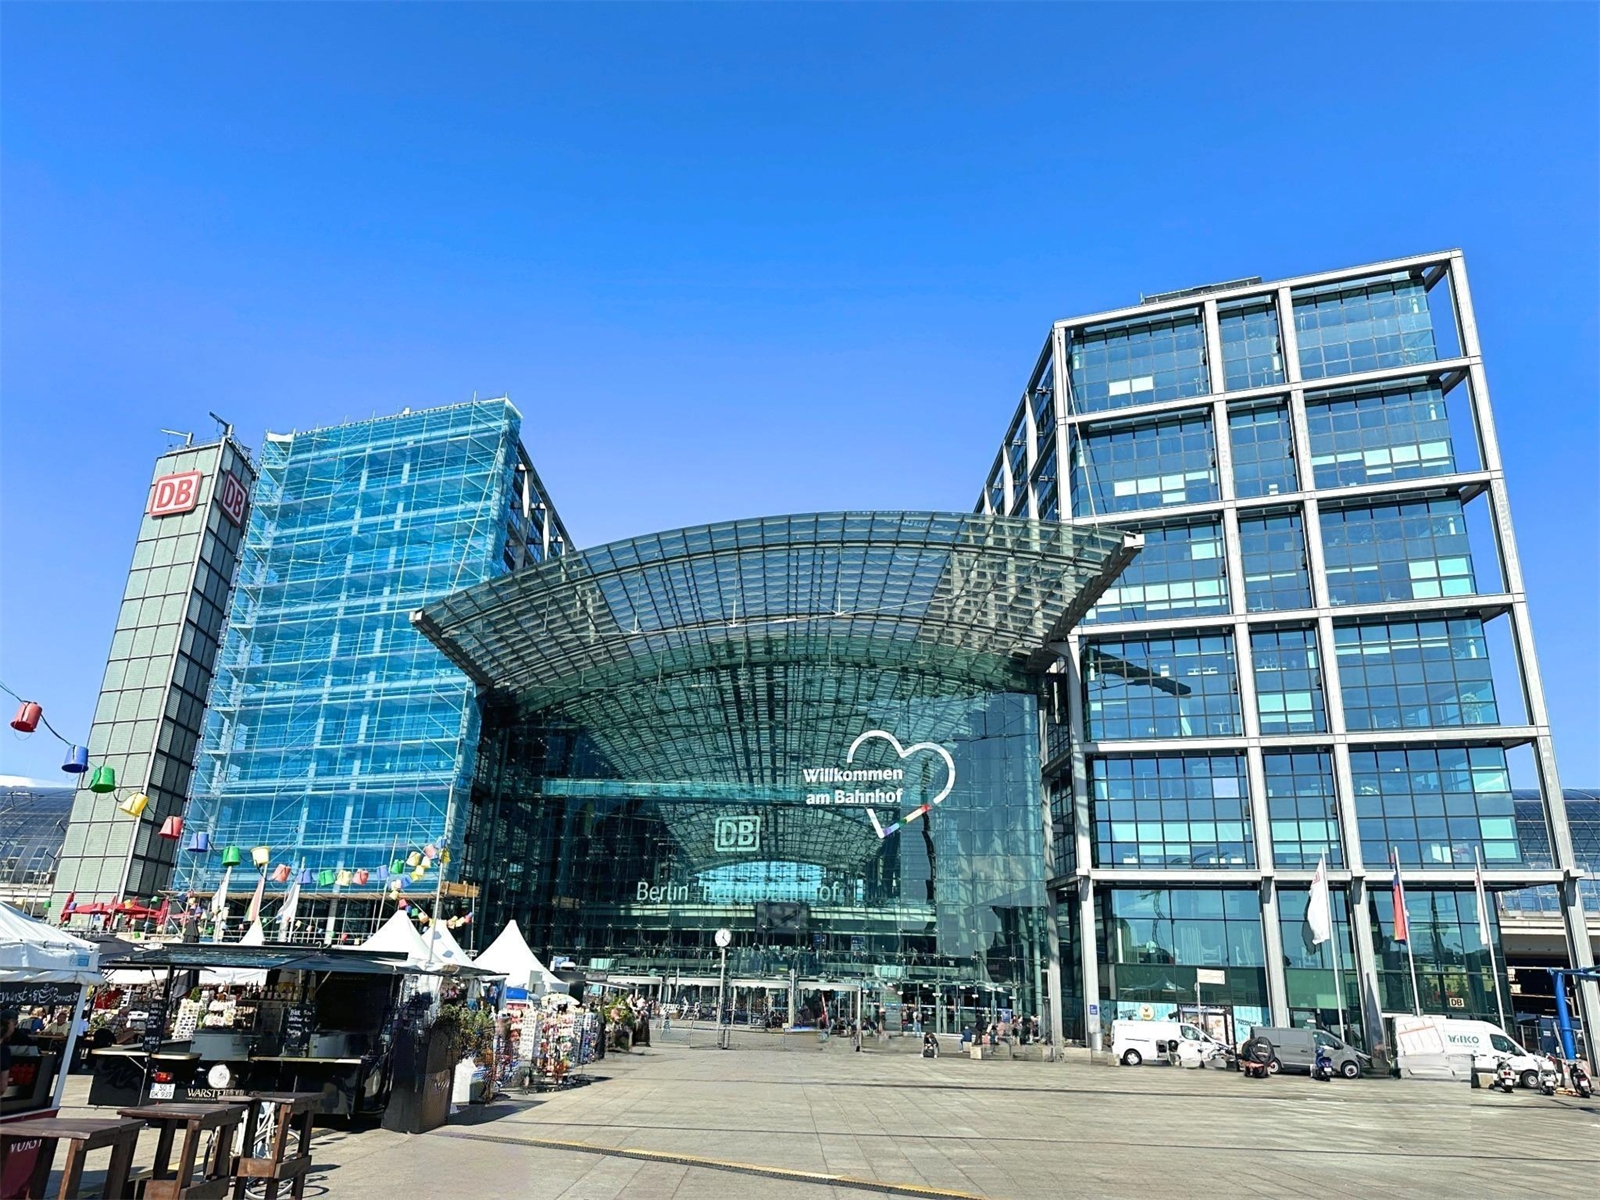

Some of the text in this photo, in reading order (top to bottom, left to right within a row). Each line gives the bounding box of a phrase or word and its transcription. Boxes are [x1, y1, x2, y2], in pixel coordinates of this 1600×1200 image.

[156, 478, 193, 509] DB
[224, 478, 244, 519] DB
[802, 767, 903, 783] Willkommen
[805, 787, 903, 805] am Bahnhof
[719, 821, 756, 847] DB
[636, 881, 689, 901] Berlin
[1450, 998, 1463, 1007] DB
